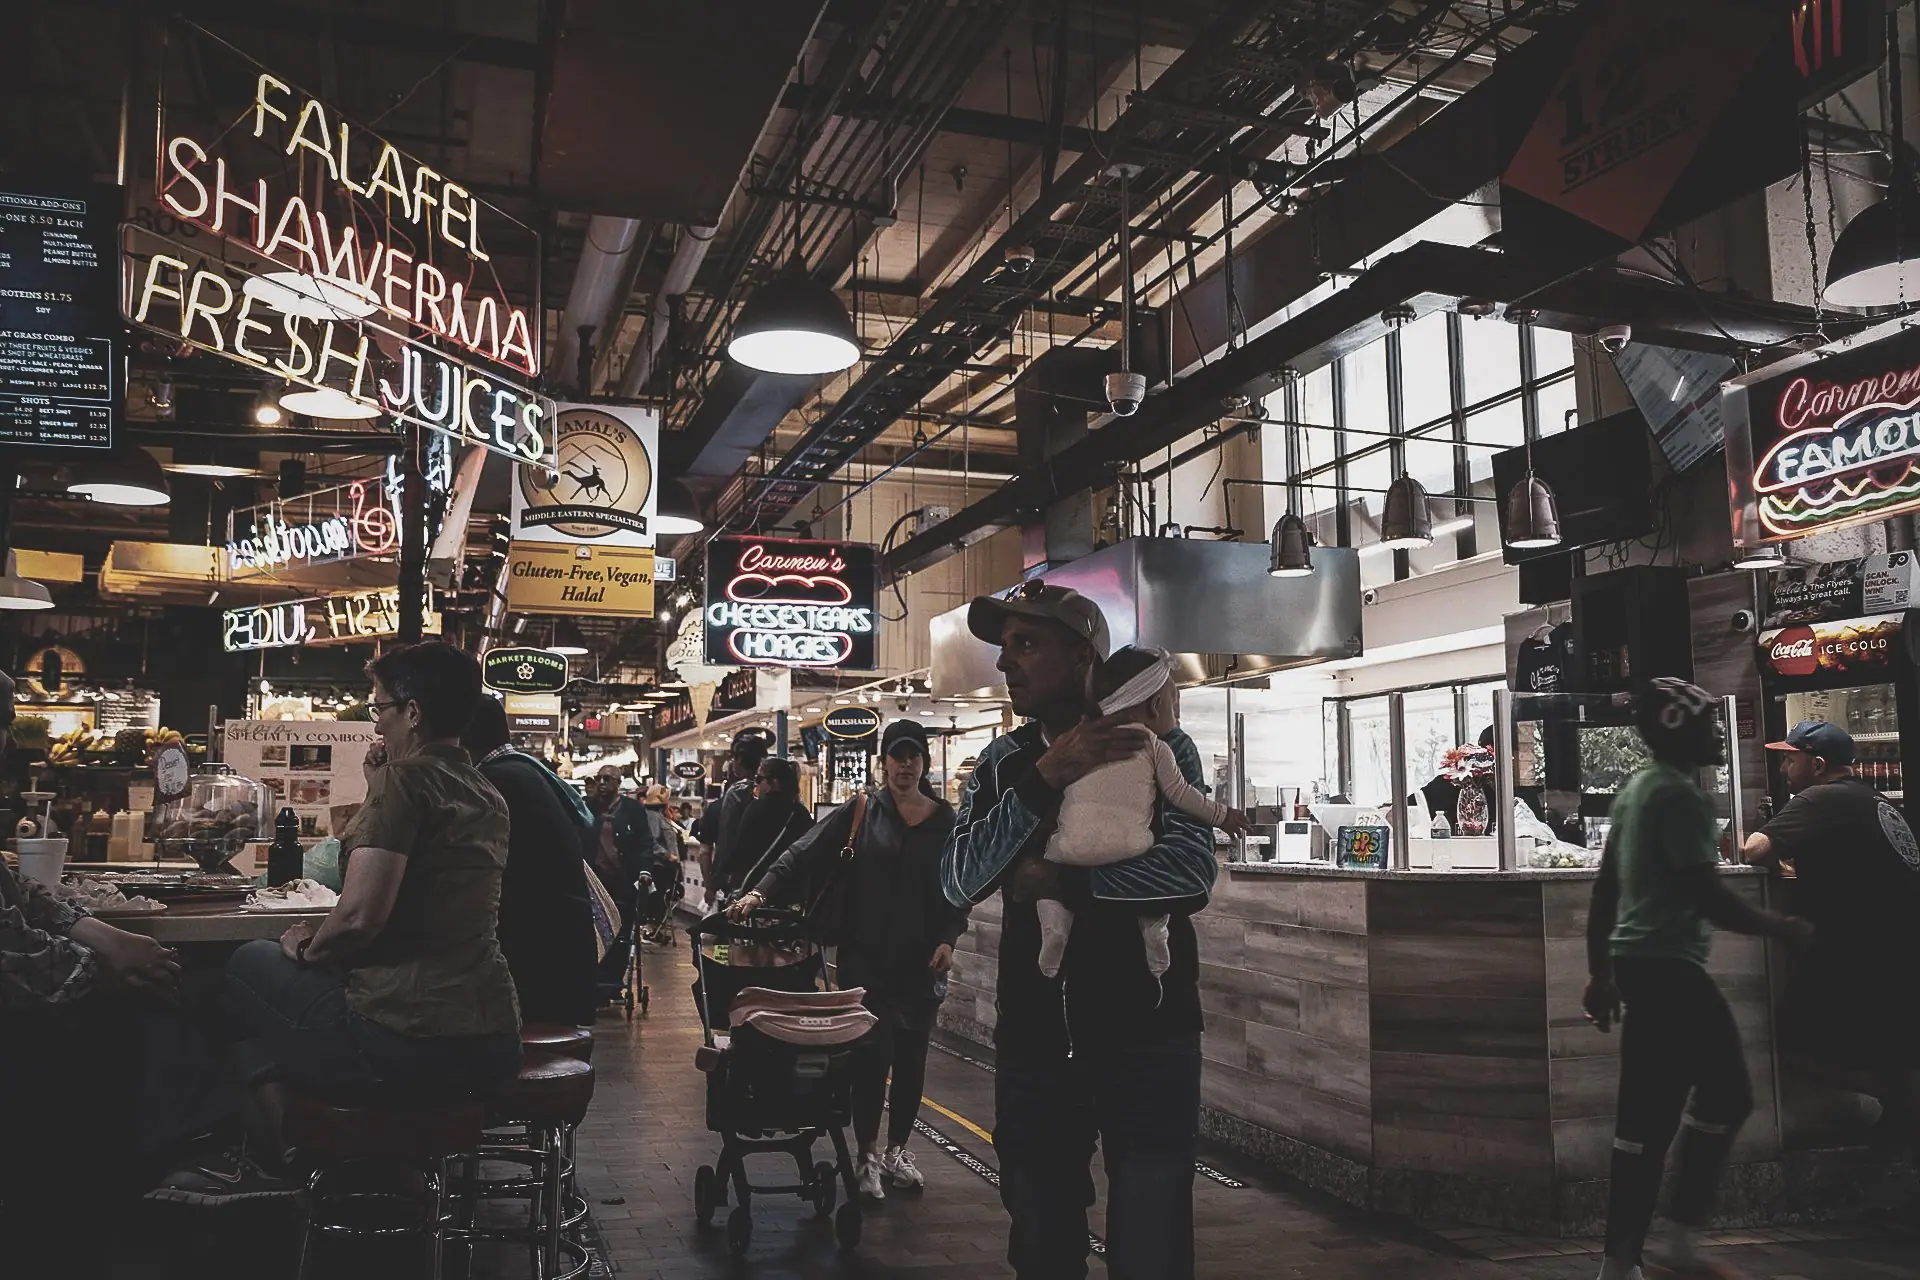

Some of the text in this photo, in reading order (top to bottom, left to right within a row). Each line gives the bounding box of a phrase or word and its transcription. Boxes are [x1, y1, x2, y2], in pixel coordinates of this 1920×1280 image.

[1564, 92, 1690, 184] STREET
[254, 73, 490, 262] FALAFEL
[0, 195, 82, 211] ITIONAL ADD-ONS
[57, 218, 84, 229] EACH
[164, 137, 537, 374] SHAWERMA
[44, 291, 73, 302] $1.75
[35, 305, 52, 314] SOY
[135, 254, 369, 398] FRESH
[13, 331, 42, 340] GRASS
[44, 334, 75, 343] COMBO
[20, 396, 51, 405] SHOTS
[379, 346, 544, 461] JUICES
[524, 510, 645, 530] MIDDLE EASTERN SPECIALTIES
[740, 545, 846, 572] Carmen's
[512, 561, 652, 587] Gluten-Free, Vegan,
[1866, 571, 1890, 581] SCAN.
[1802, 584, 1808, 592] &
[1810, 583, 1825, 591] The
[1827, 578, 1855, 590] Flyers.
[1865, 578, 1900, 588] UNLOCK.
[1865, 586, 1884, 596] WIN!
[560, 586, 606, 603] Halal
[1775, 594, 1802, 605] Always
[1810, 590, 1832, 602] great
[1834, 587, 1851, 596] call.
[707, 602, 872, 632] CHEESESTEAKS
[743, 633, 838, 660] HOAGIES
[1771, 639, 1888, 660] Coca-Cola ICE COLD
[488, 655, 564, 671] MARKET BLOOMS
[515, 718, 550, 726] PASTRIES
[827, 717, 876, 726] MILKSHAKES
[227, 732, 375, 742] SPECIALTY COMBOS
[1344, 830, 1381, 853] TIPS
[799, 1016, 832, 1026] doona
